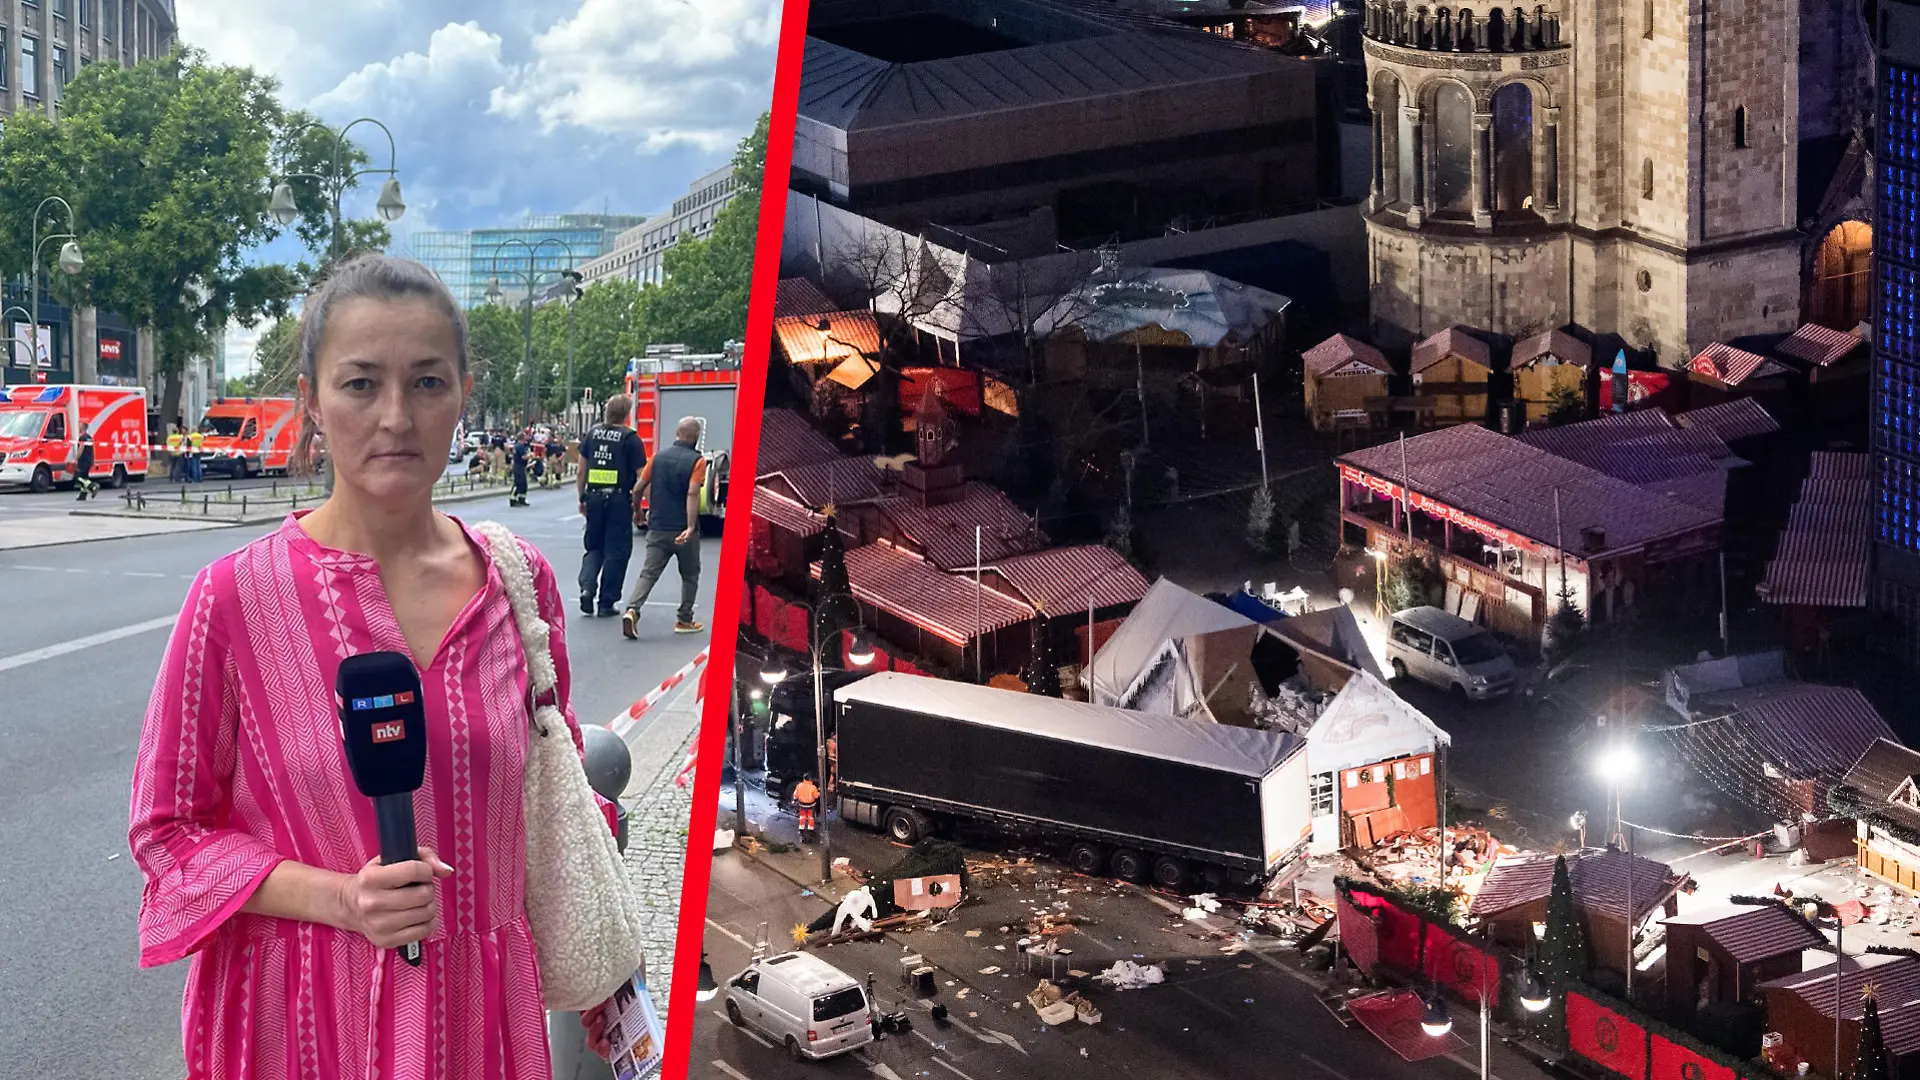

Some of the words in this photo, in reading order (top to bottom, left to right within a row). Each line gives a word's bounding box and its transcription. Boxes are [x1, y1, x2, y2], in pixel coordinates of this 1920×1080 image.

[592, 429, 622, 442] POLIZEI
[111, 430, 142, 460] 112
[356, 694, 410, 709] RTL
[376, 723, 402, 740] ntv
